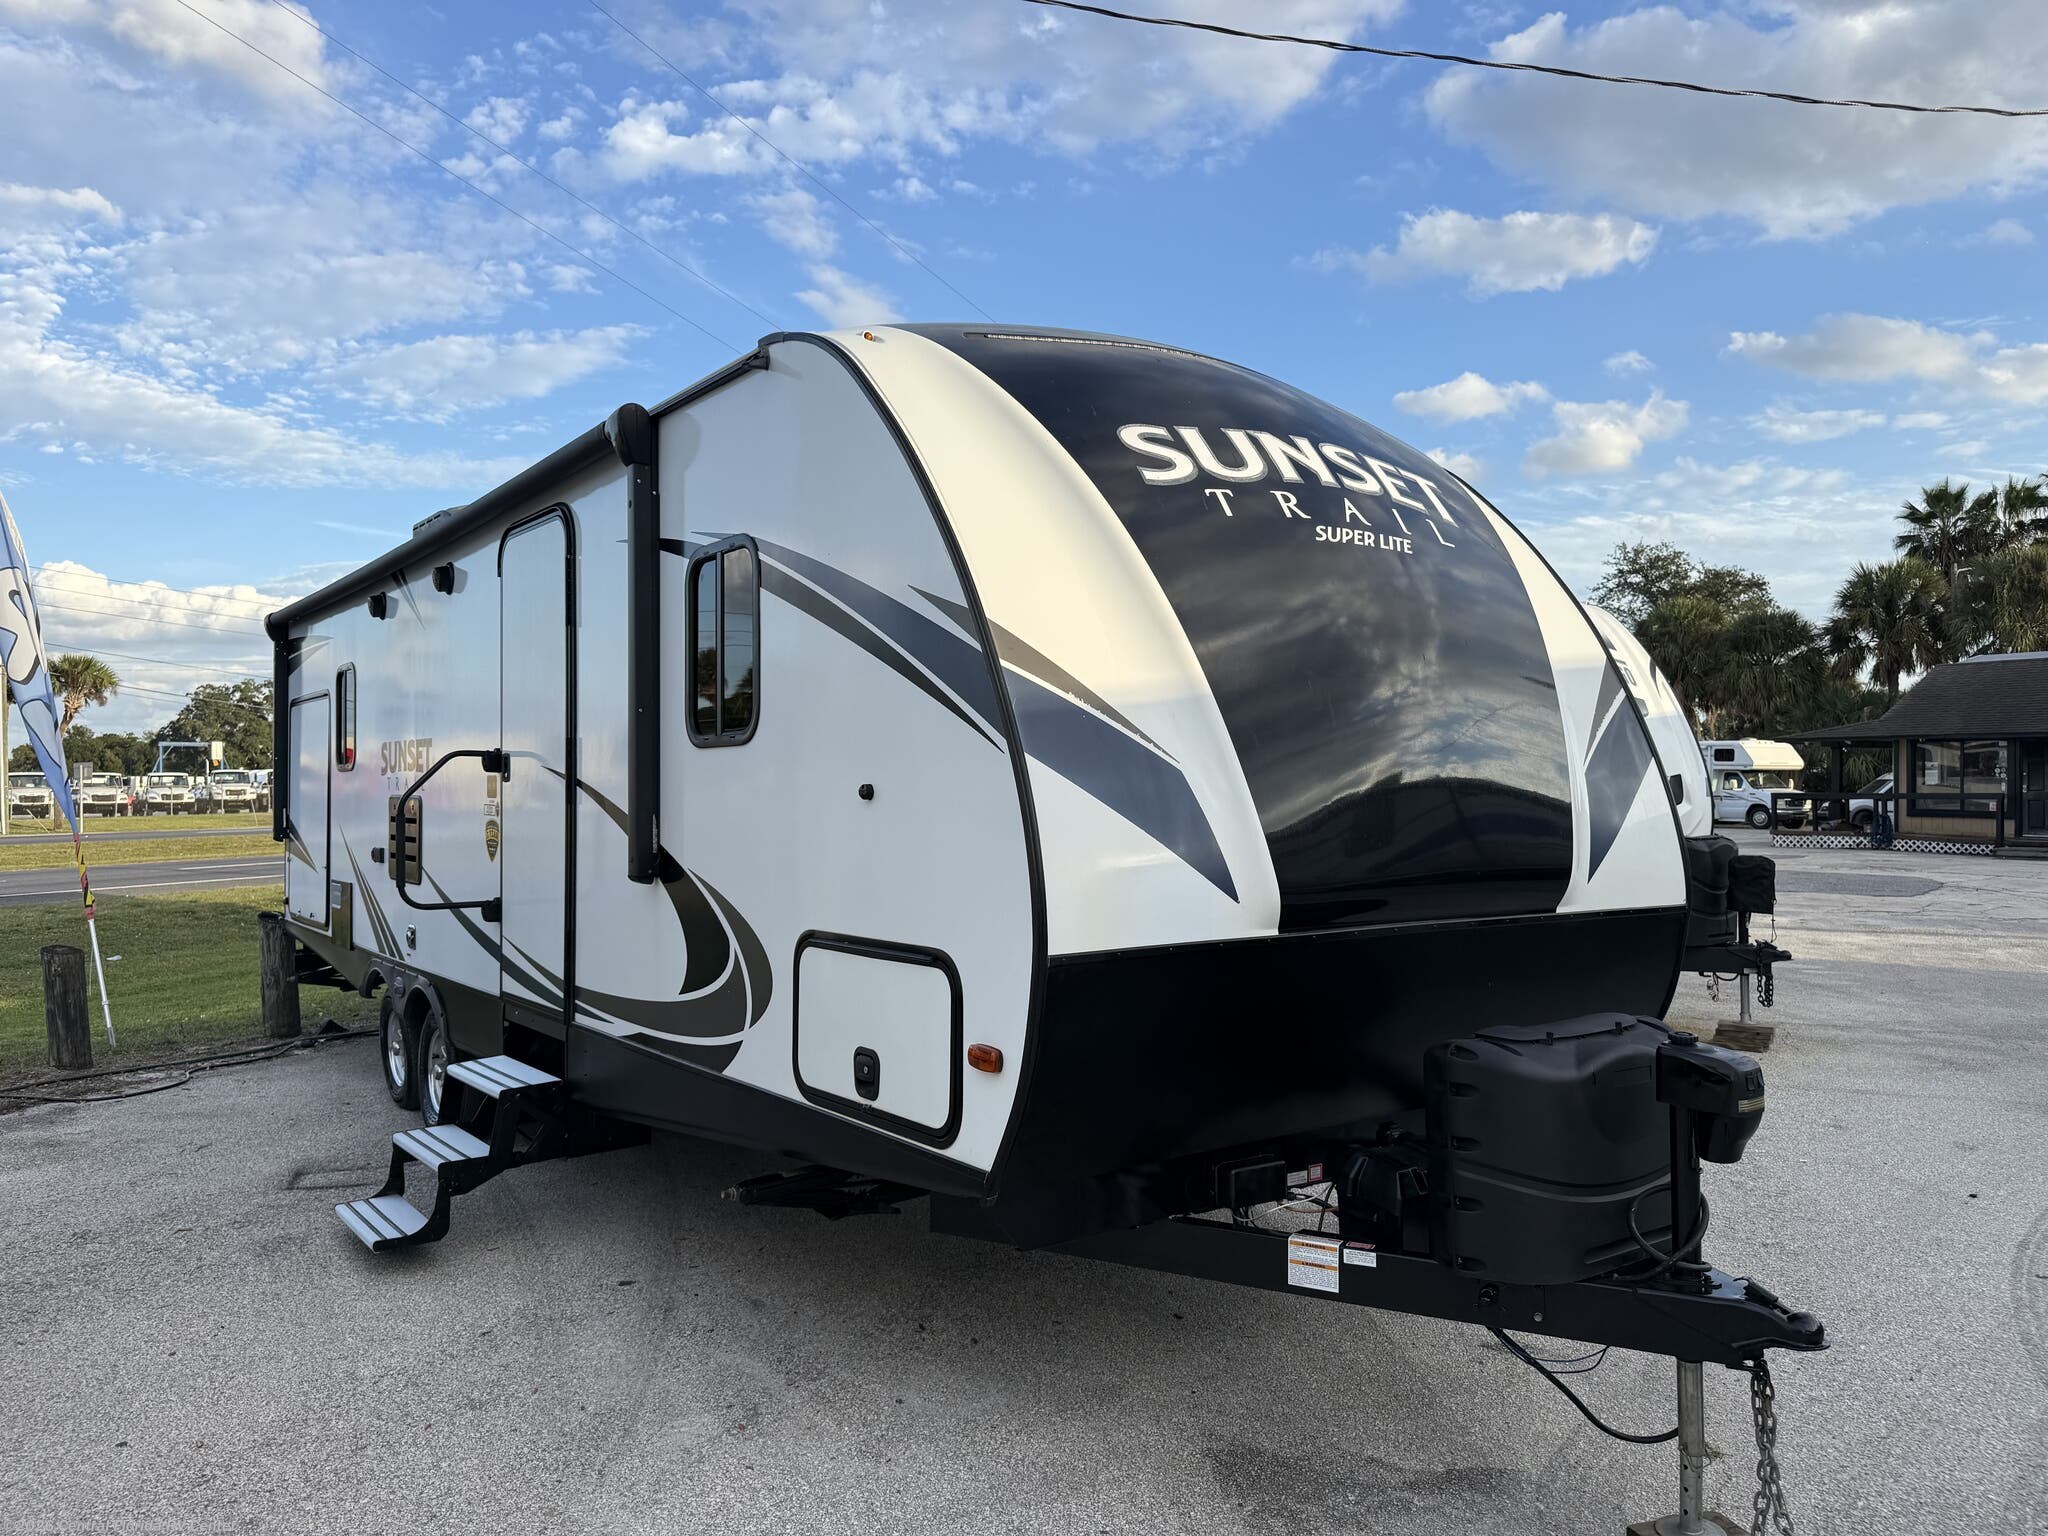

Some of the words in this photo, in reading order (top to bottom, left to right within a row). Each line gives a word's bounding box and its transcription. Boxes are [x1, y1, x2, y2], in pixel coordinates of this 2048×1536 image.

[1116, 423, 1458, 528] SUNSET
[1205, 488, 1456, 548] TRAIL
[1315, 525, 1375, 547] SUPER
[1379, 534, 1413, 554] LITE
[381, 739, 432, 776] SUNSET
